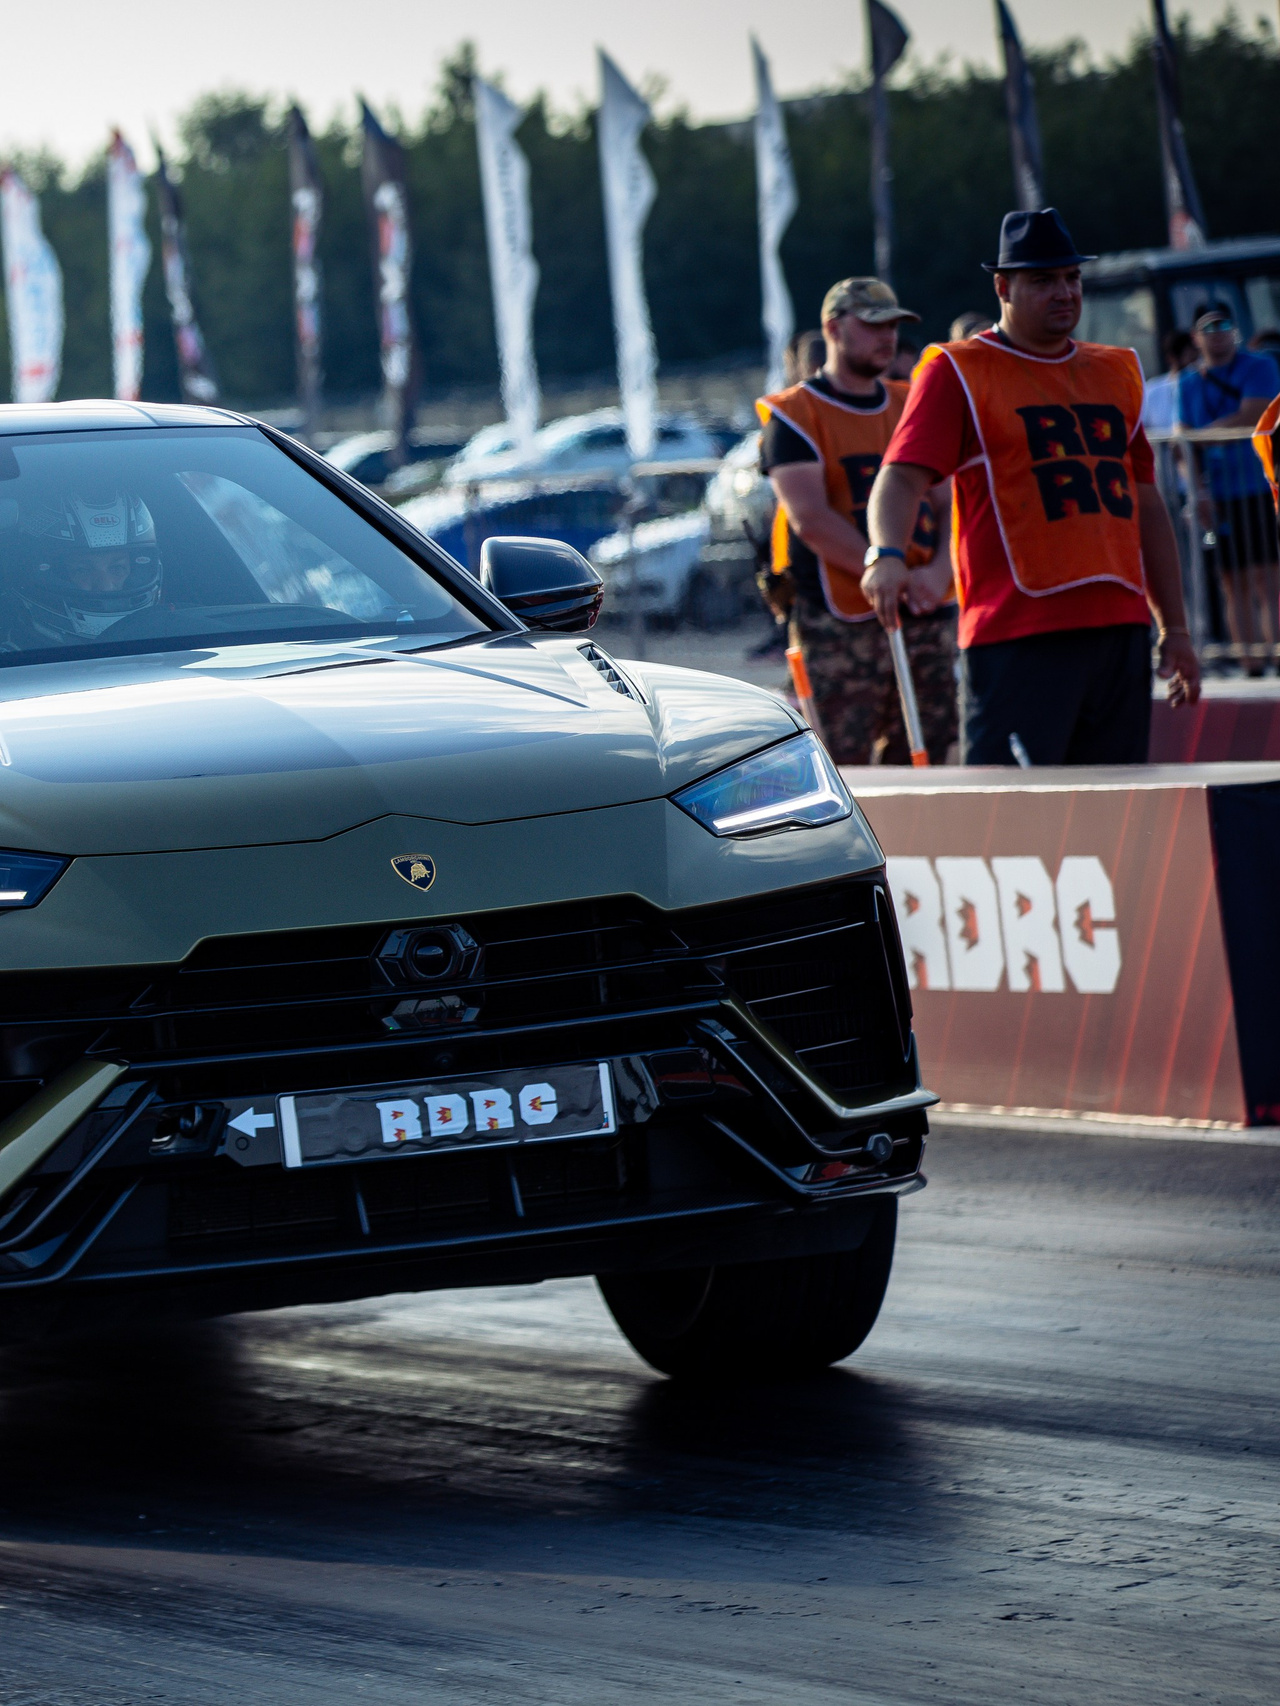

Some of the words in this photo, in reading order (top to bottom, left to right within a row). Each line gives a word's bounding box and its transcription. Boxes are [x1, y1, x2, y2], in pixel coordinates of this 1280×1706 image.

[1015, 404, 1128, 461] RD
[93, 516, 117, 524] BELL
[1030, 459, 1134, 522] RC
[885, 855, 1122, 995] RDRC
[375, 1082, 559, 1144] RDRC
